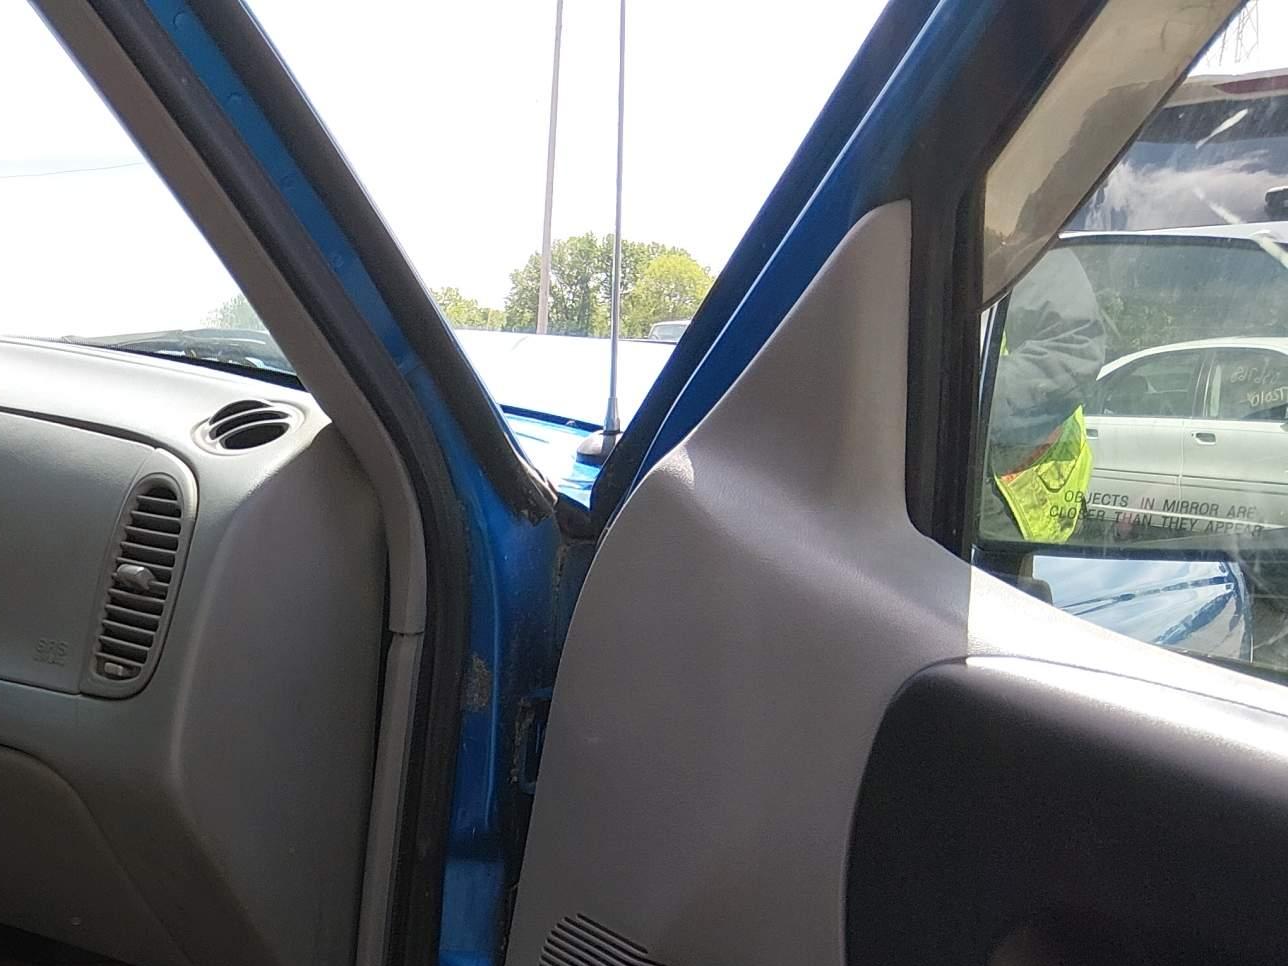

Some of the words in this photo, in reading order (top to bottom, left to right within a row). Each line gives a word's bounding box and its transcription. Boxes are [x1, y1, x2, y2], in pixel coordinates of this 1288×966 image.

[1064, 490, 1129, 508] OBJECTS
[1140, 497, 1155, 511] IN
[1162, 499, 1220, 516] MIRROR
[1226, 504, 1257, 519] ARE
[1114, 511, 1153, 526] THAN
[1161, 515, 1200, 531] THEY
